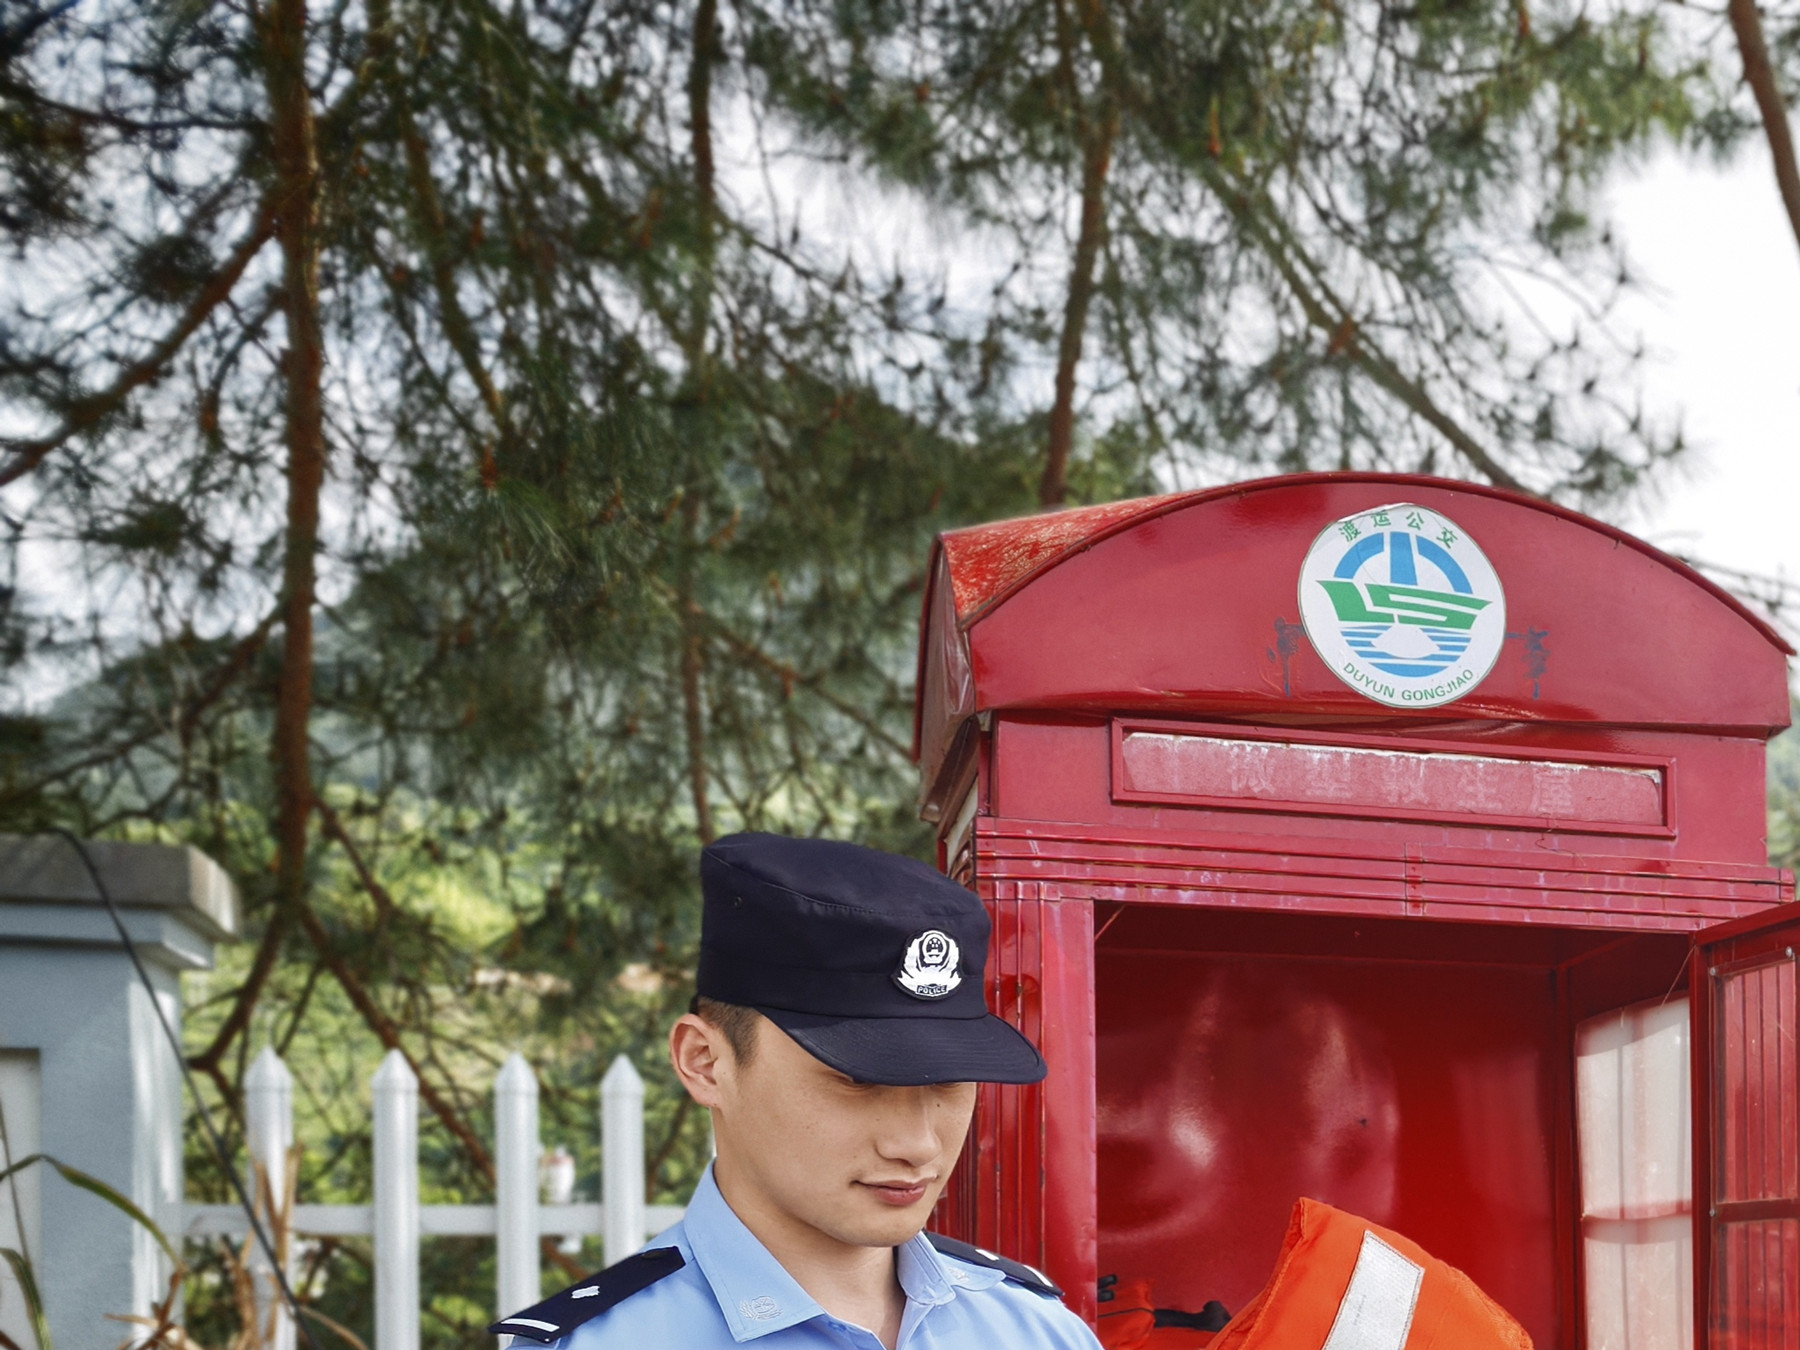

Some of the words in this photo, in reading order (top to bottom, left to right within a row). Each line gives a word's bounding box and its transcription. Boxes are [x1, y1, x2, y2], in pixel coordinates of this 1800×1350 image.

[1338, 509, 1458, 549] 渡运公交
[1343, 662, 1395, 698] DUYUN
[1401, 668, 1474, 701] GONGJIAO
[917, 986, 946, 994] POLICE
